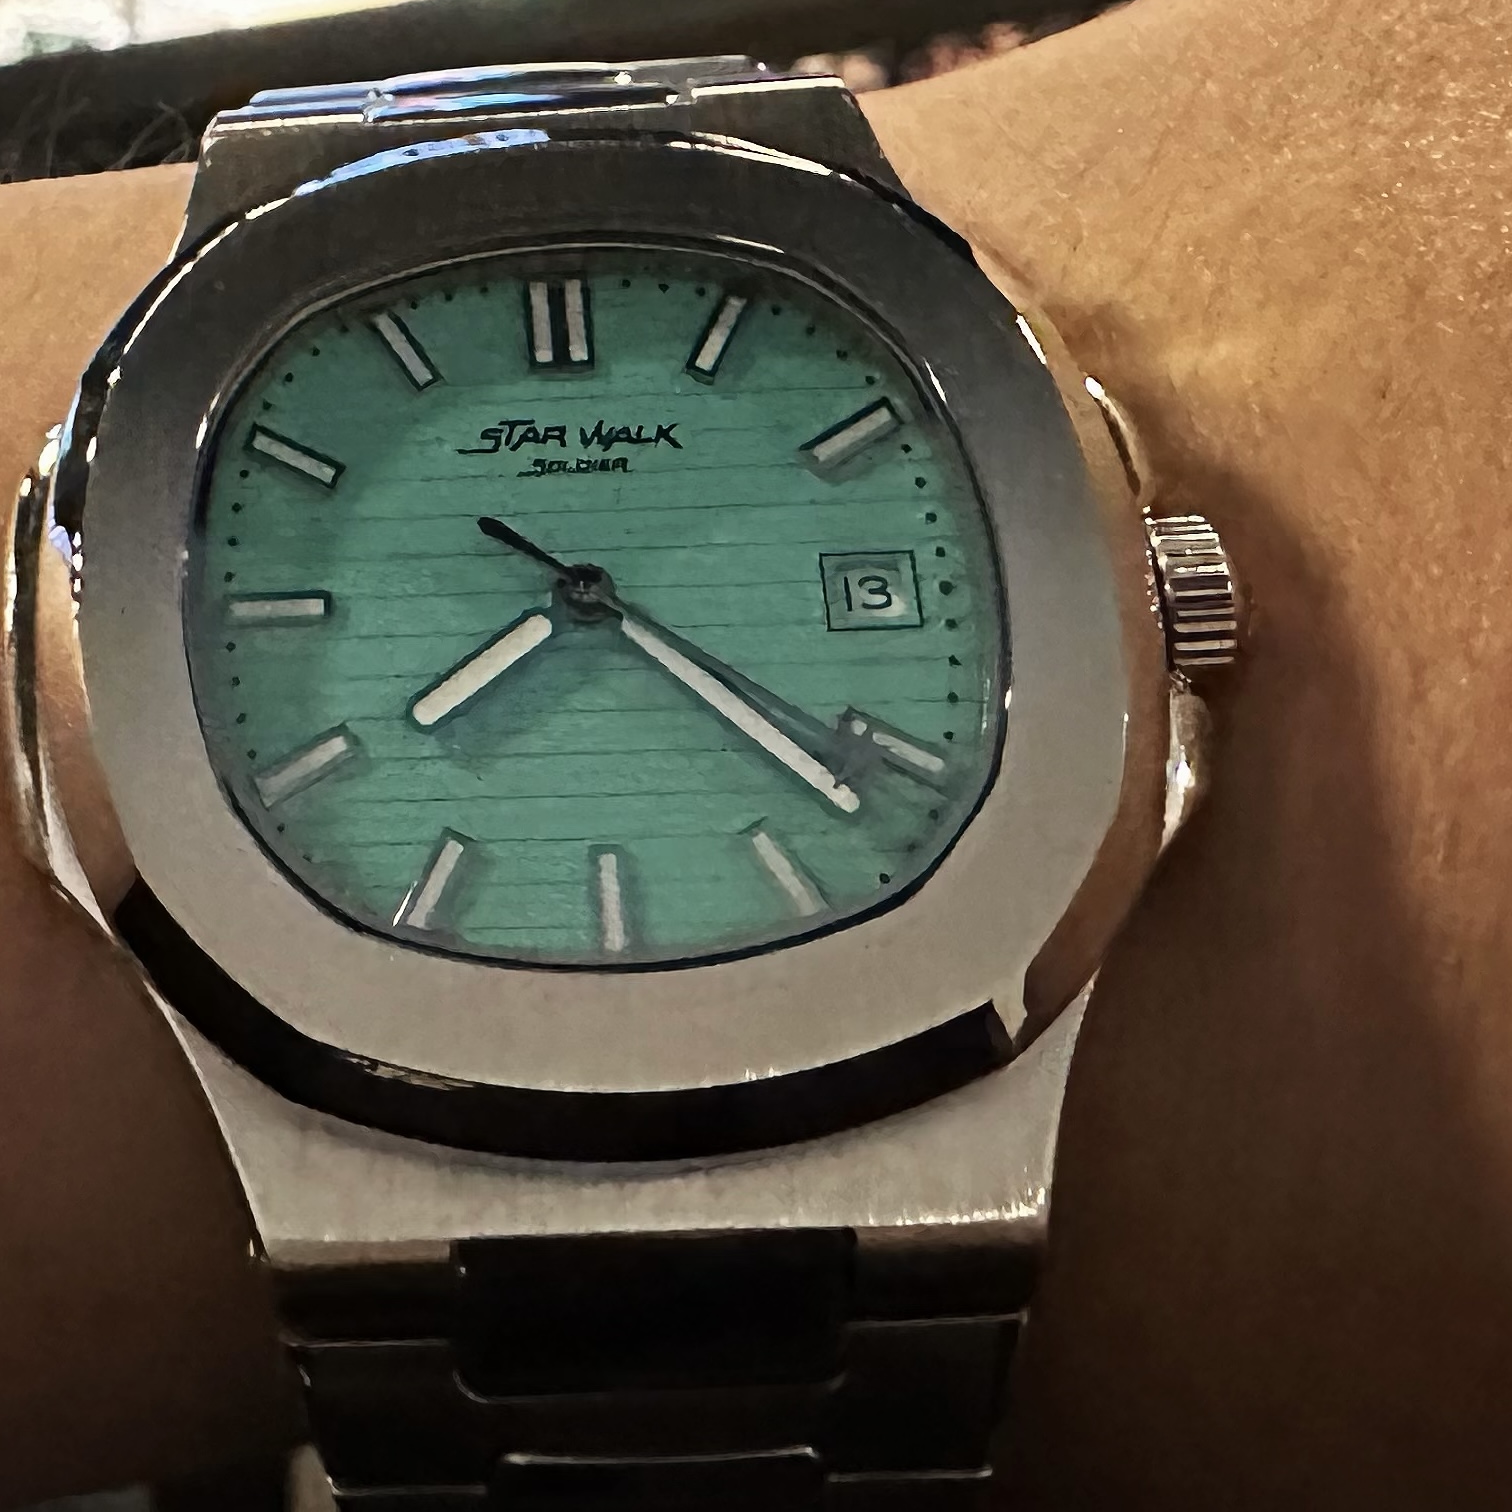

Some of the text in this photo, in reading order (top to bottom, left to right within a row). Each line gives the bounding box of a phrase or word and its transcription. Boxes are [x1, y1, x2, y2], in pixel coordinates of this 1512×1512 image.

[456, 419, 683, 454] STAR WALK
[844, 575, 893, 612] 13
